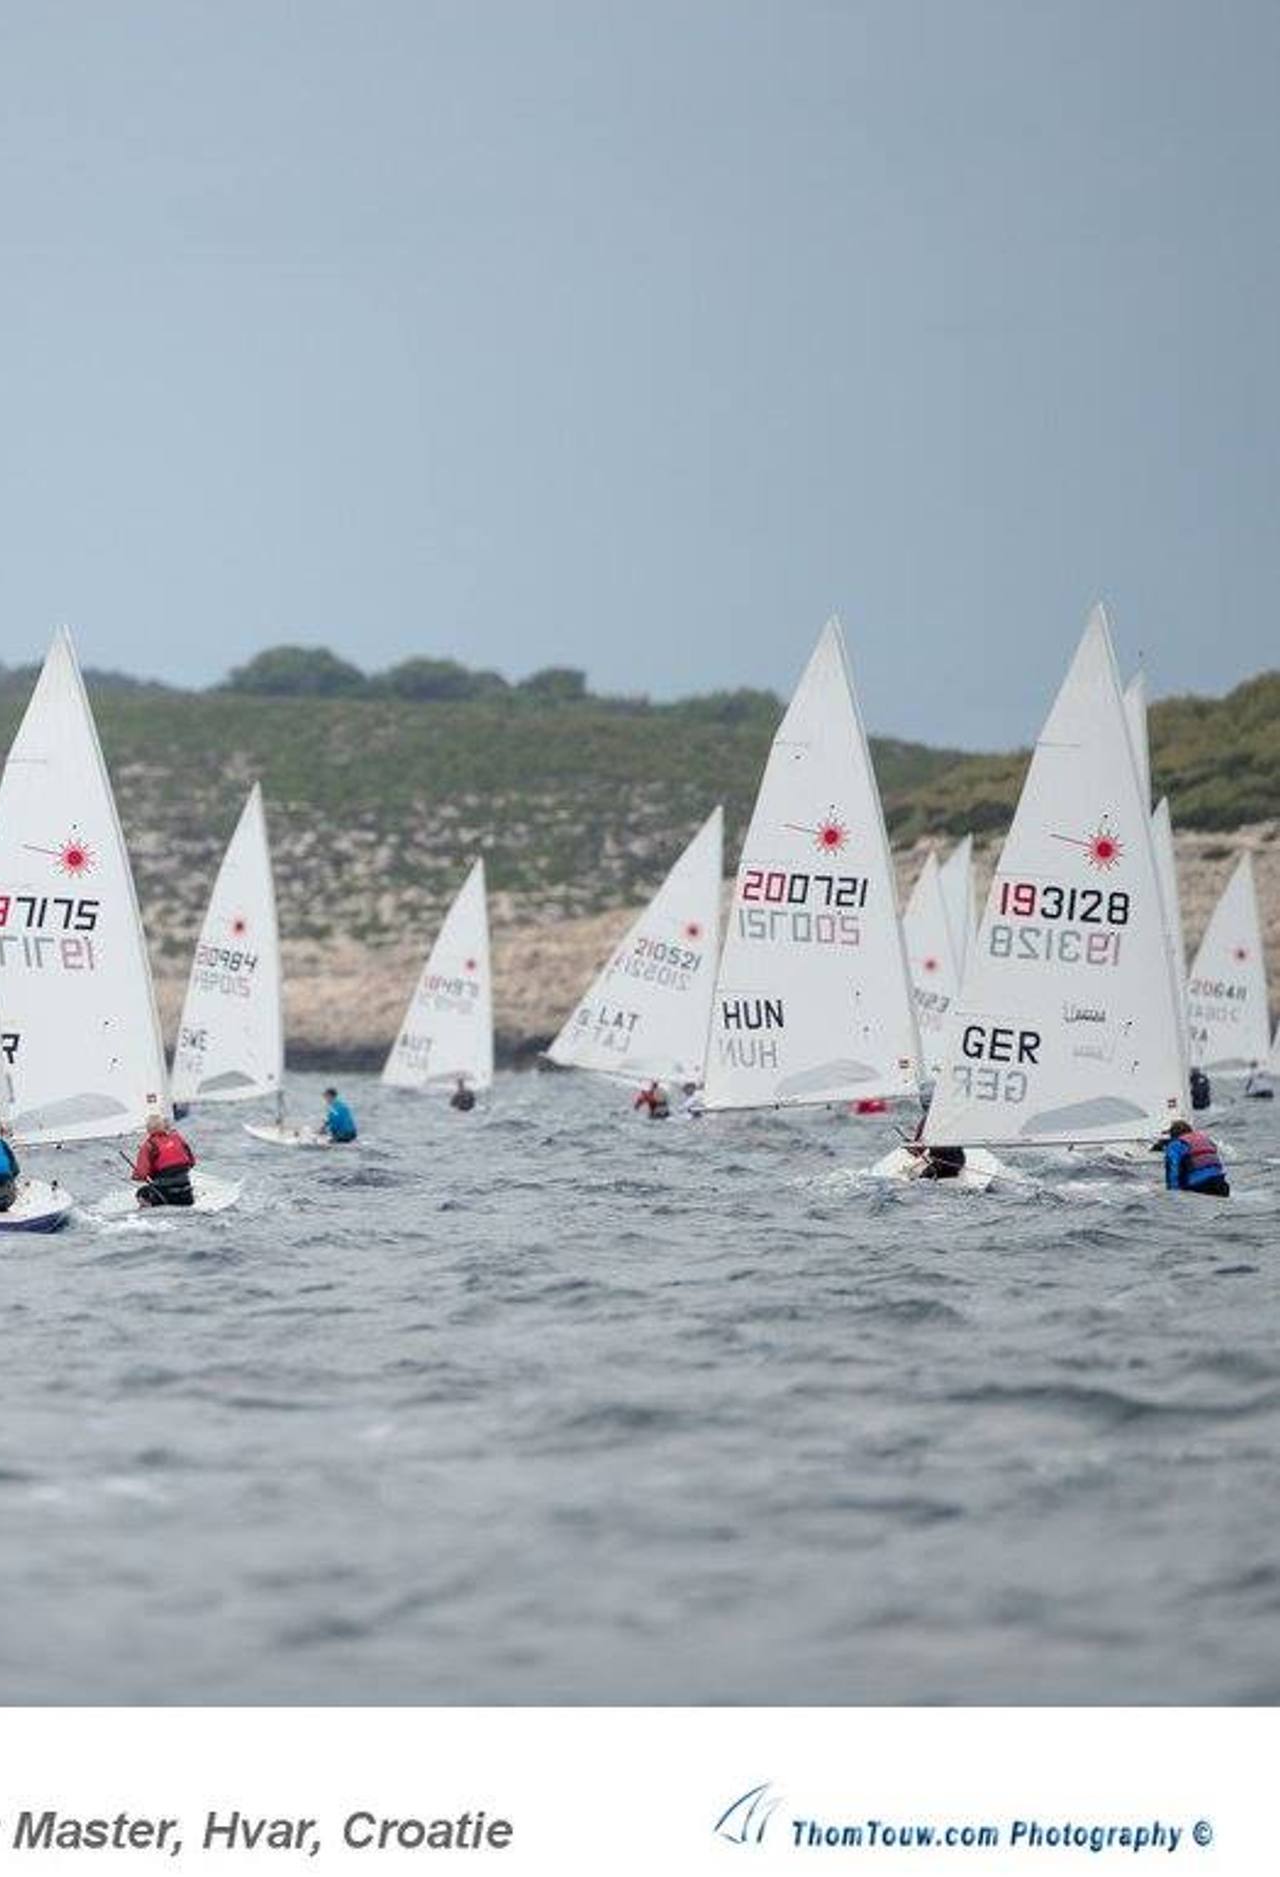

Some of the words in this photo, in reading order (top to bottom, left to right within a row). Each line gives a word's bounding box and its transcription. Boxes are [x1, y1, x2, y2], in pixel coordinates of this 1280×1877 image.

[742, 870, 869, 907] 200721
[999, 882, 1130, 925] 193128
[600, 1006, 639, 1033] LAT
[722, 1000, 785, 1029] HUN
[962, 1025, 1042, 1064] GER
